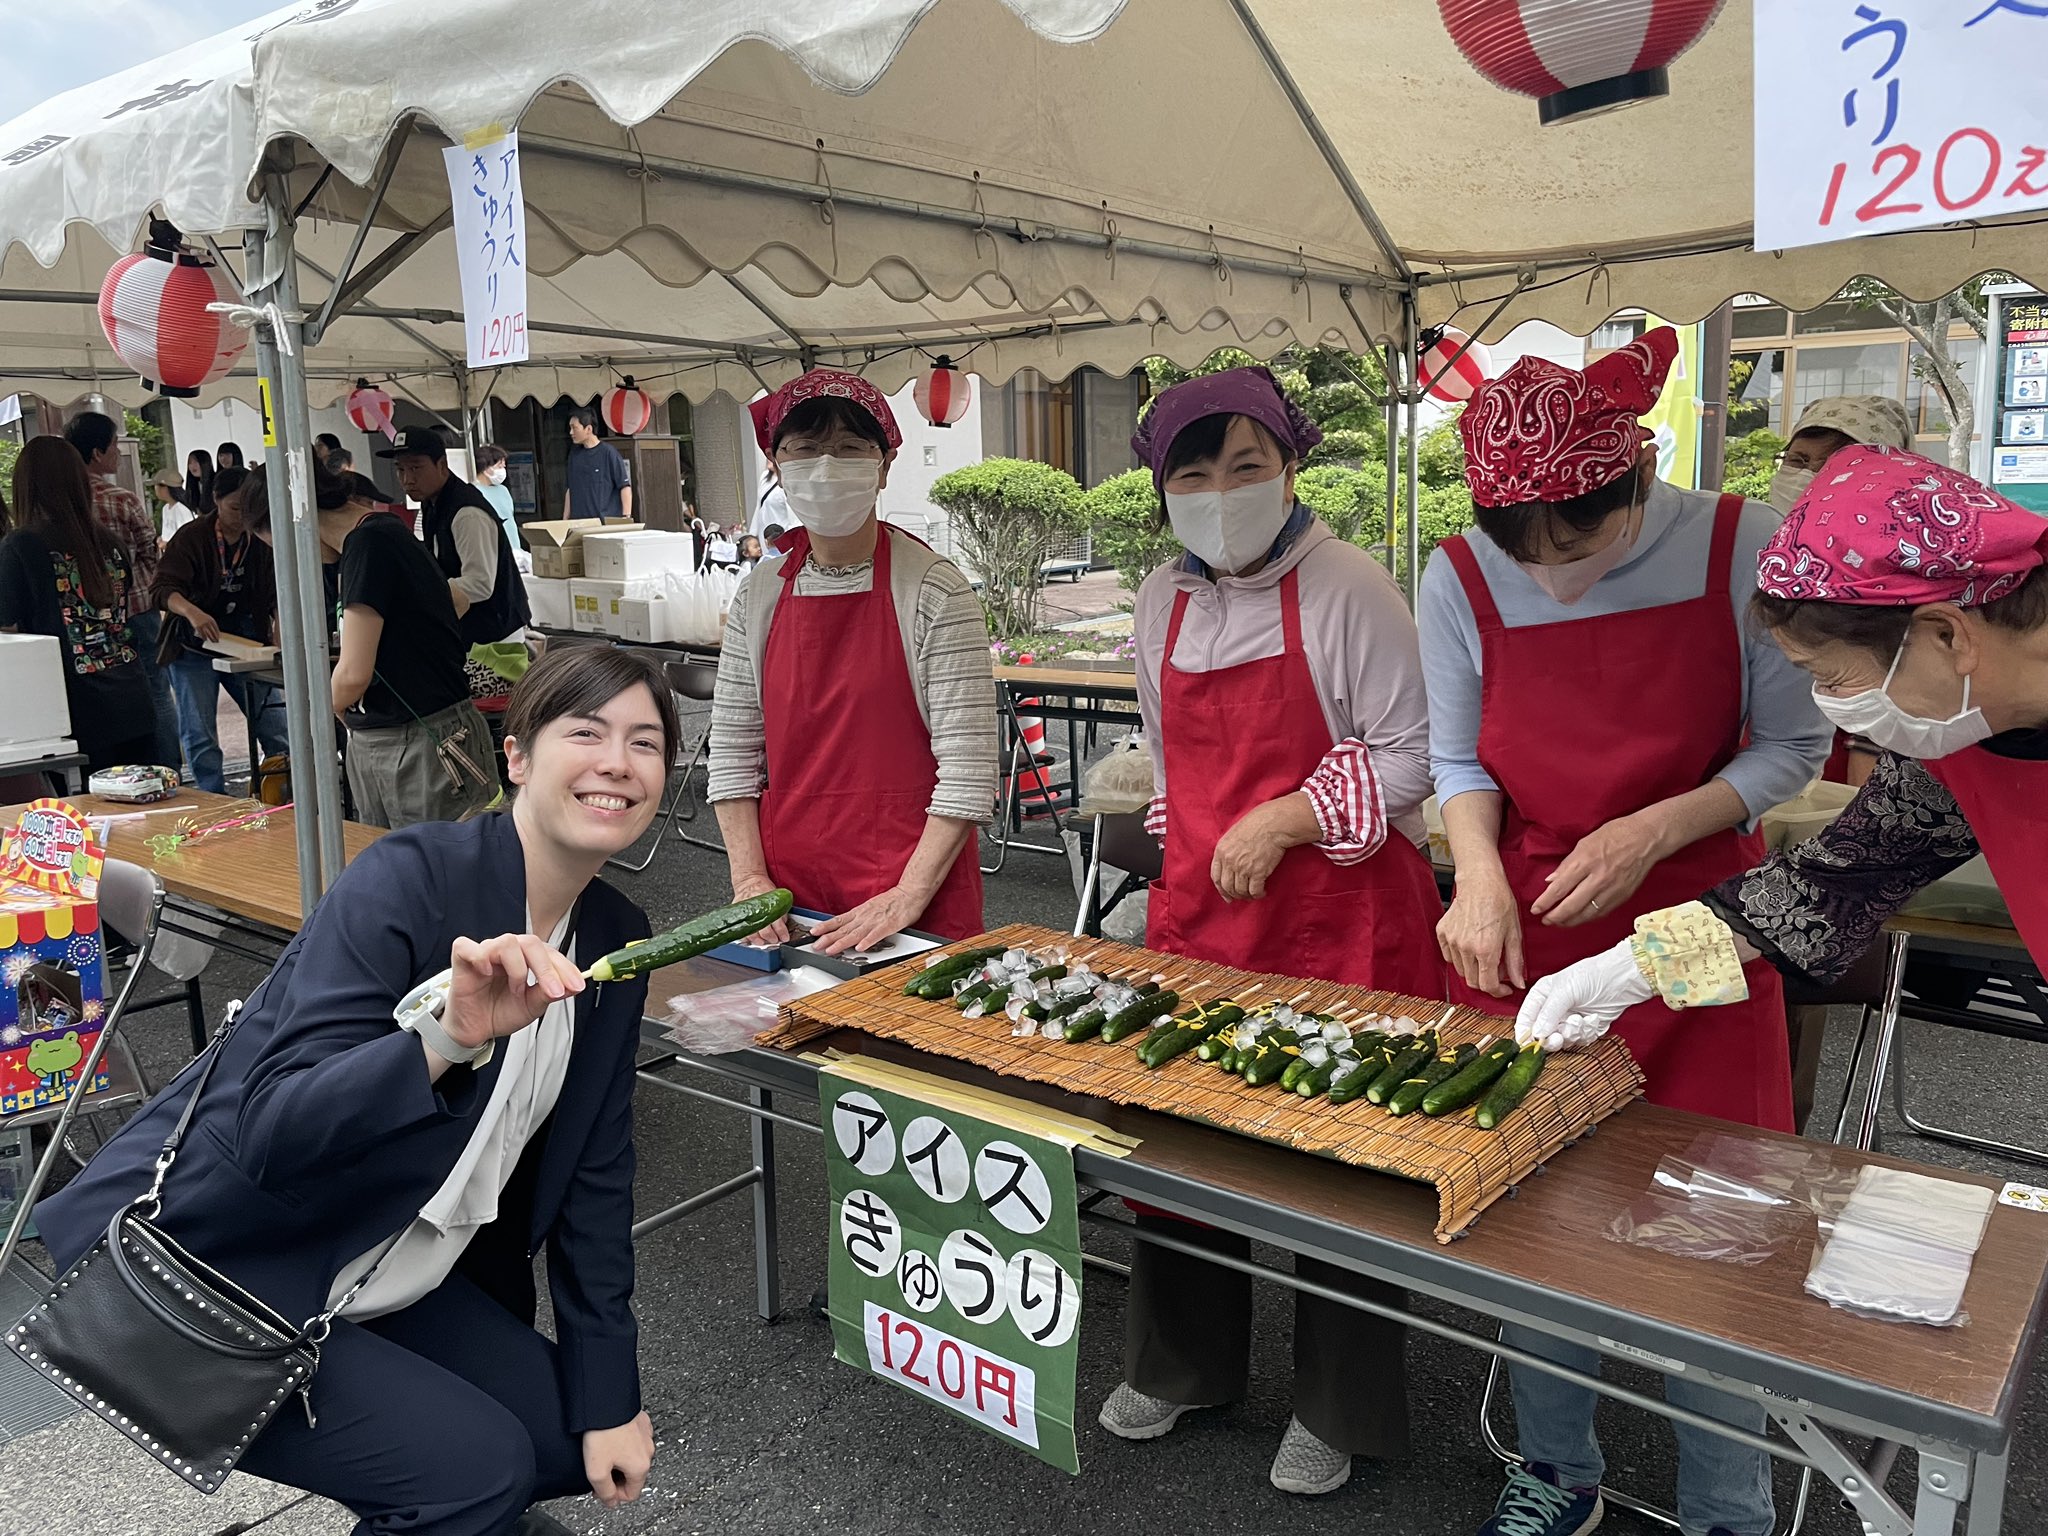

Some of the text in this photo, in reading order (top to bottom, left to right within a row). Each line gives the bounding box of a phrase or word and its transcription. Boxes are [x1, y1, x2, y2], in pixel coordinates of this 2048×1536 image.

[472, 154, 499, 313] きゅうり
[500, 148, 520, 267] アイス
[481, 312, 525, 360] 120円
[836, 1099, 1046, 1226] アイス
[845, 1192, 1063, 1342] きゅうり
[877, 1312, 1019, 1429] 120円
